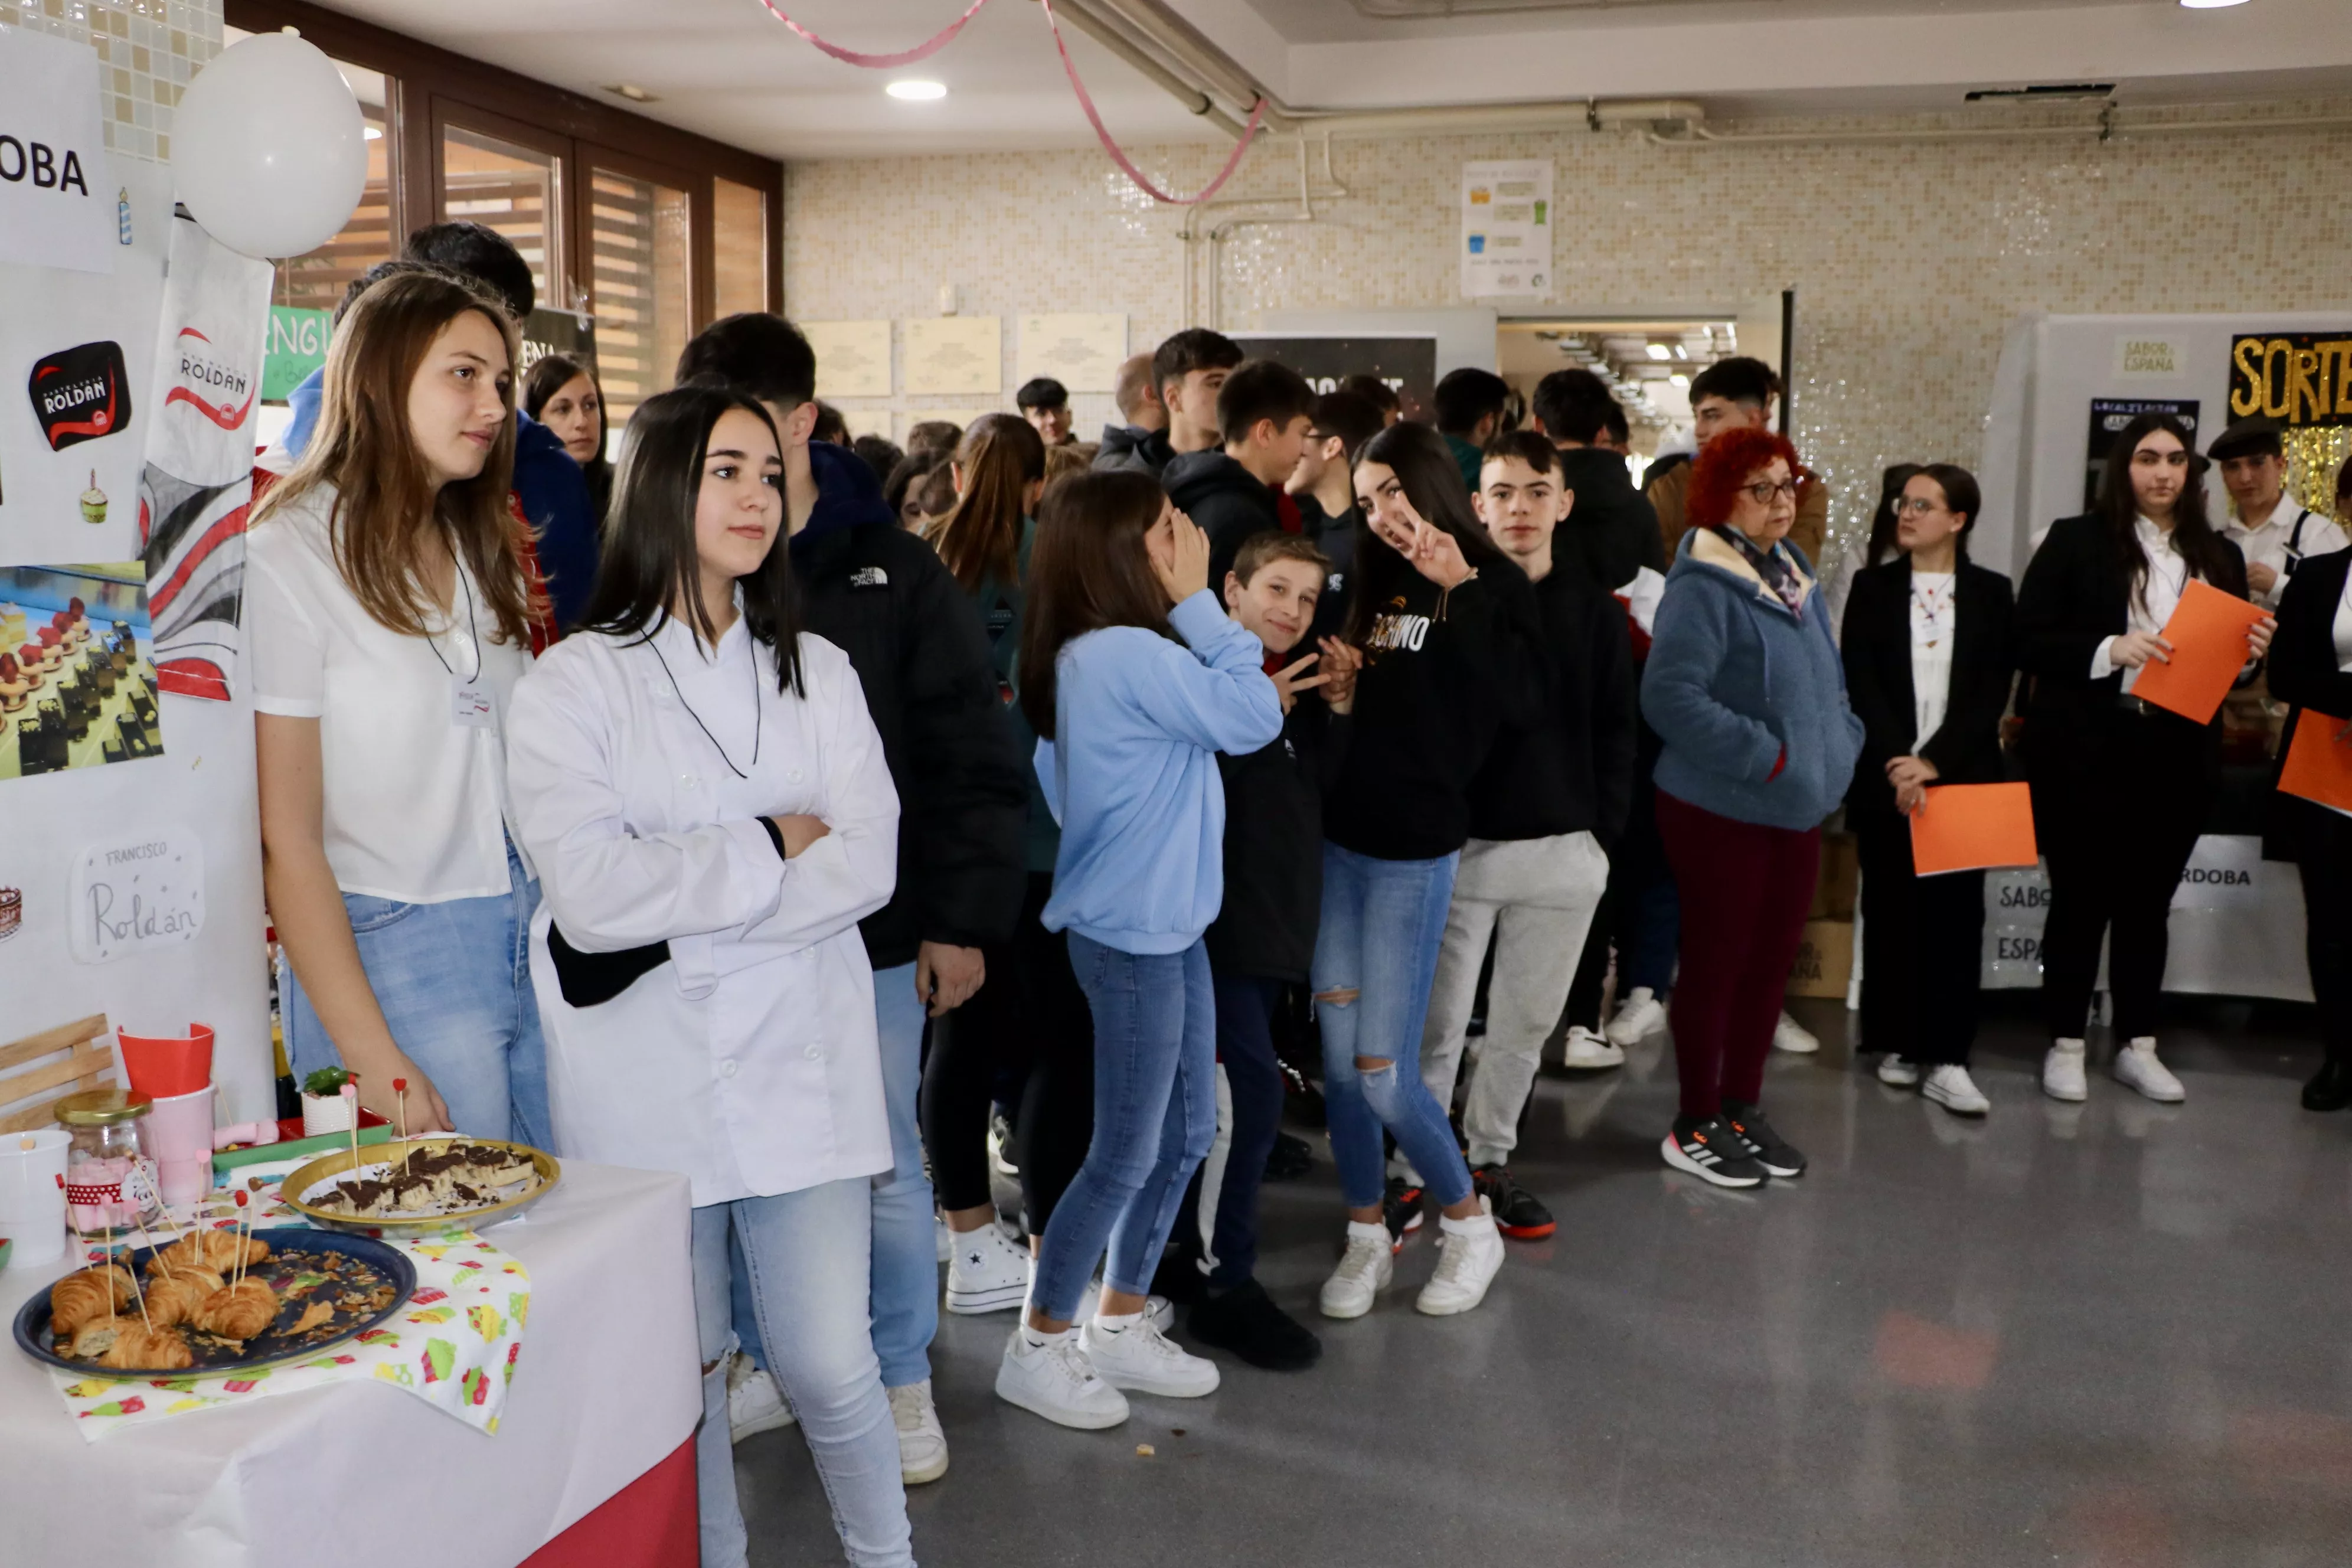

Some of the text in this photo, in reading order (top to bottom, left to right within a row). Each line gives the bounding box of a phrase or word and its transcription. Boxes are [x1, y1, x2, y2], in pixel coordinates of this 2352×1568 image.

[181, 358, 246, 395] ROLDAN
[44, 381, 106, 414] ROLDAN
[105, 841, 167, 867] FRANCISCO
[87, 882, 198, 946] Roldán
